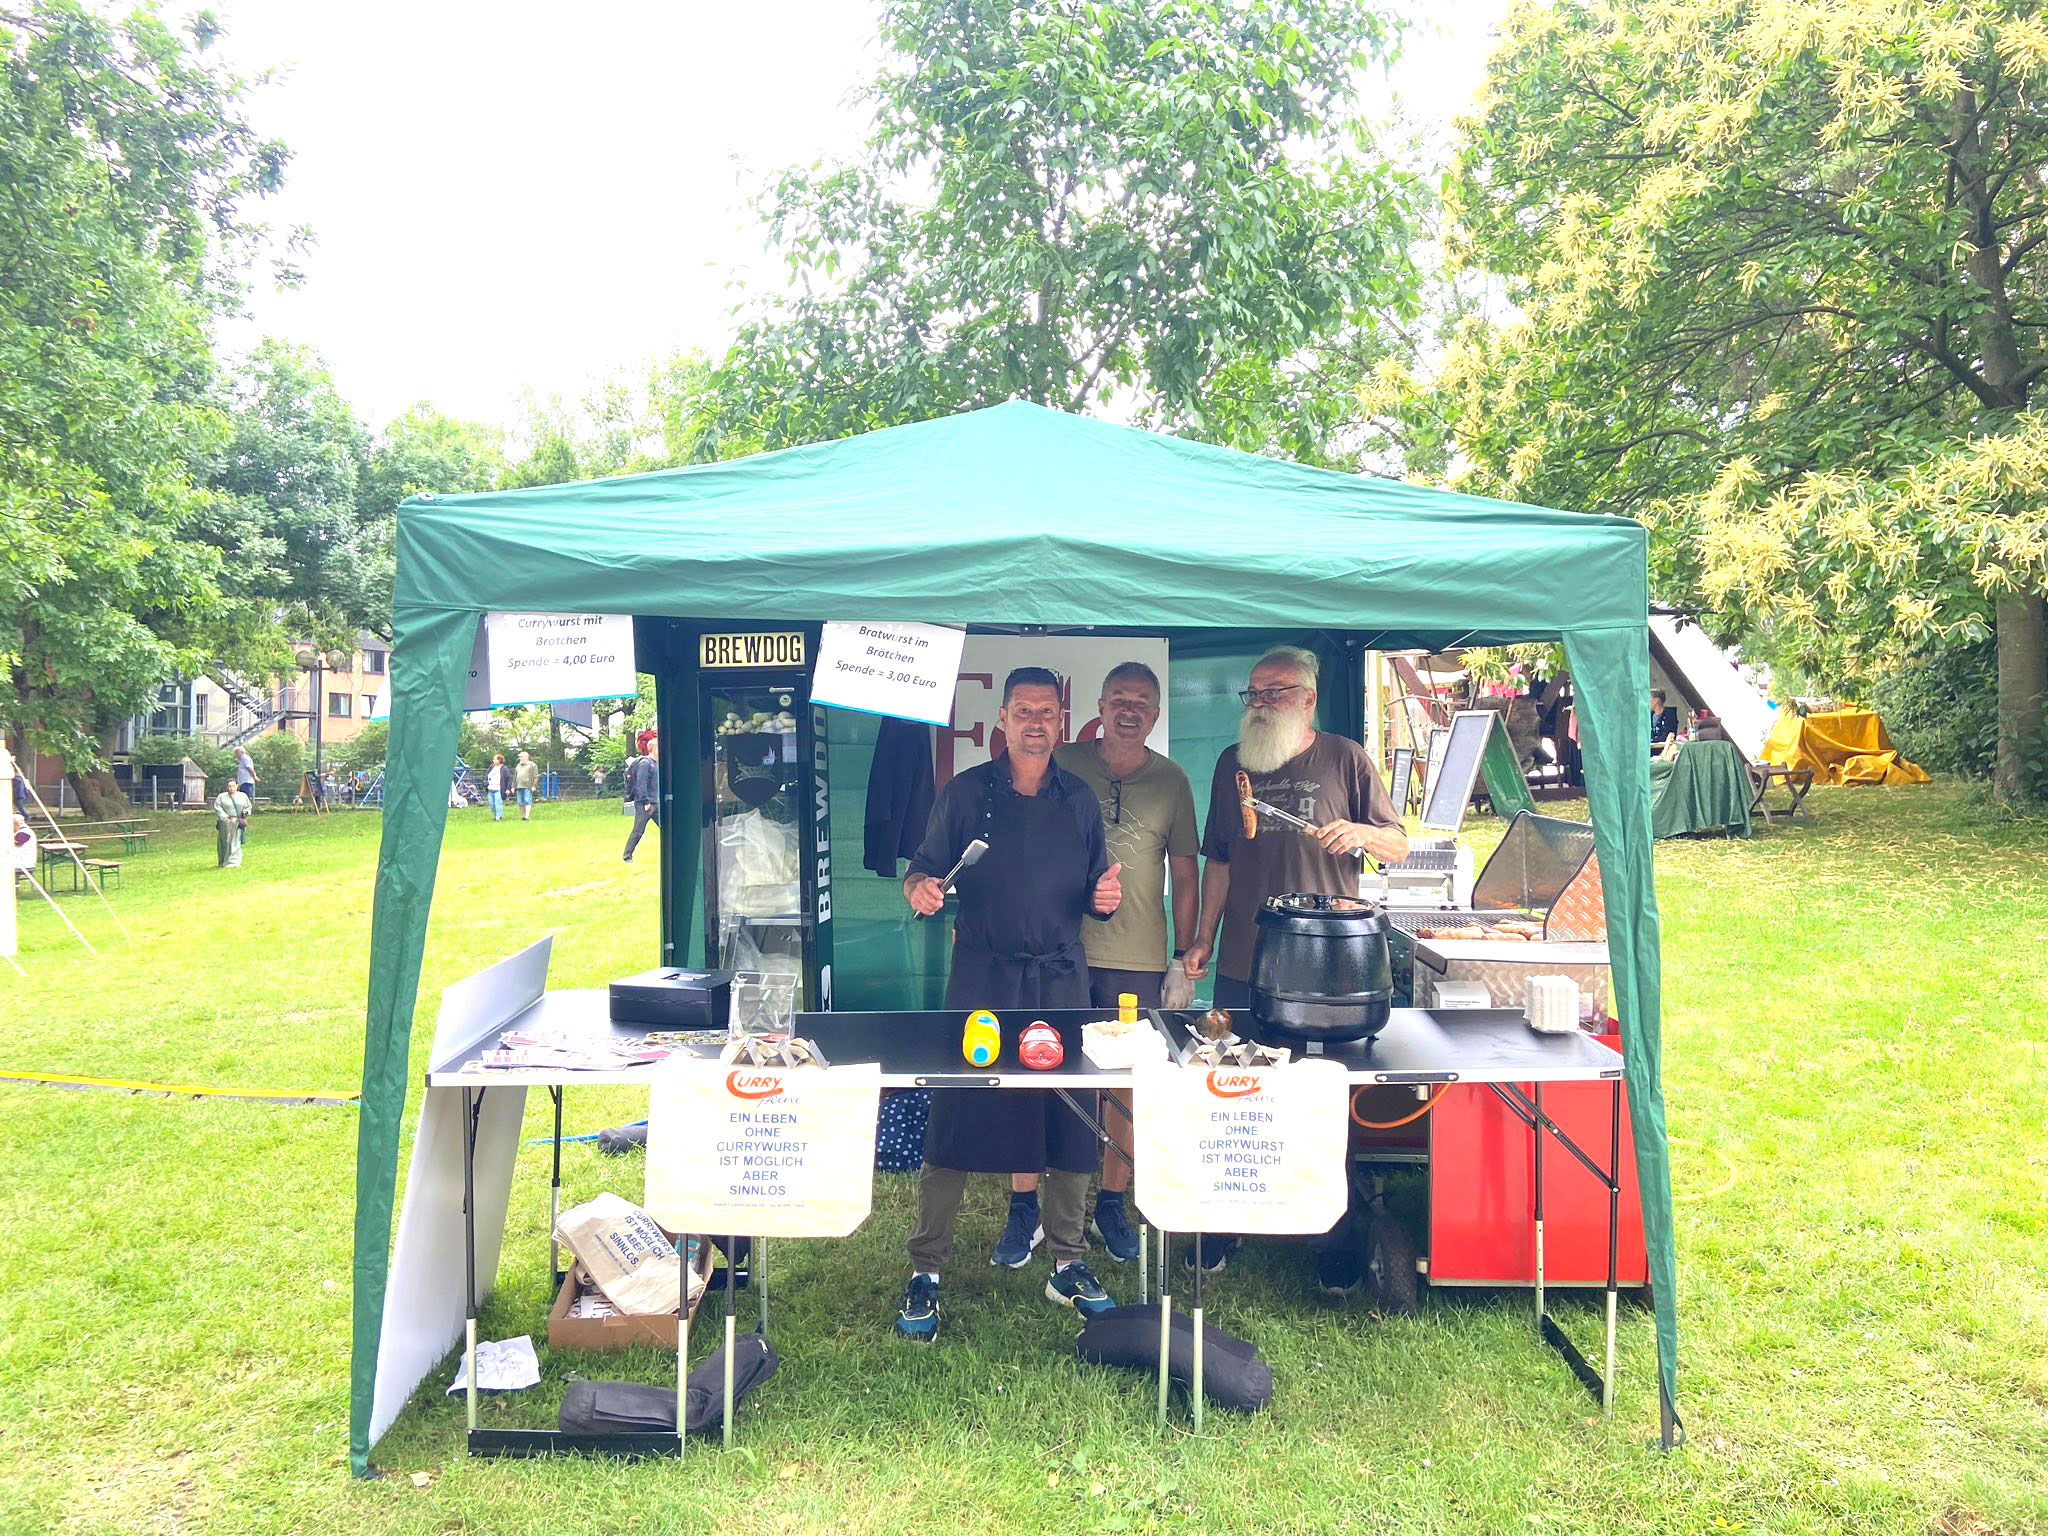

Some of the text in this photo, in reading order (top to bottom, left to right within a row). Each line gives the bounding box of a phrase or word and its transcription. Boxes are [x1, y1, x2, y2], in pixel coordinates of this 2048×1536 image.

[518, 615, 603, 629] Currywurst mit
[859, 626, 929, 648] Bratwurst im
[705, 635, 801, 664] BREWDOG
[866, 646, 915, 664] Brötchen
[507, 657, 550, 669] Spende
[562, 654, 587, 667] 4,00
[590, 654, 615, 664] Euro
[835, 660, 875, 676] Spende
[886, 670, 911, 683] 3,00
[912, 675, 937, 689] Euro
[813, 706, 831, 924] BREWDO
[726, 1070, 784, 1099] CURRY
[1206, 1070, 1261, 1098] CURRY
[730, 1112, 797, 1124] EIN LEBEN
[1210, 1111, 1273, 1123] EIN LEBEN
[744, 1127, 781, 1137] OHNE
[1225, 1125, 1259, 1136] OHNE
[716, 1141, 809, 1152] CURRYWURST
[1199, 1139, 1285, 1151] CURRYWURST
[719, 1154, 803, 1167] IST MÖGLICH
[1202, 1154, 1221, 1164] IST
[742, 1171, 778, 1181] ABER
[1224, 1168, 1258, 1178] ABER
[624, 1215, 639, 1227] IST
[633, 1210, 676, 1256] CURRYWURST
[609, 1231, 639, 1268] SINNLOS.
[624, 1233, 645, 1252] ABER
